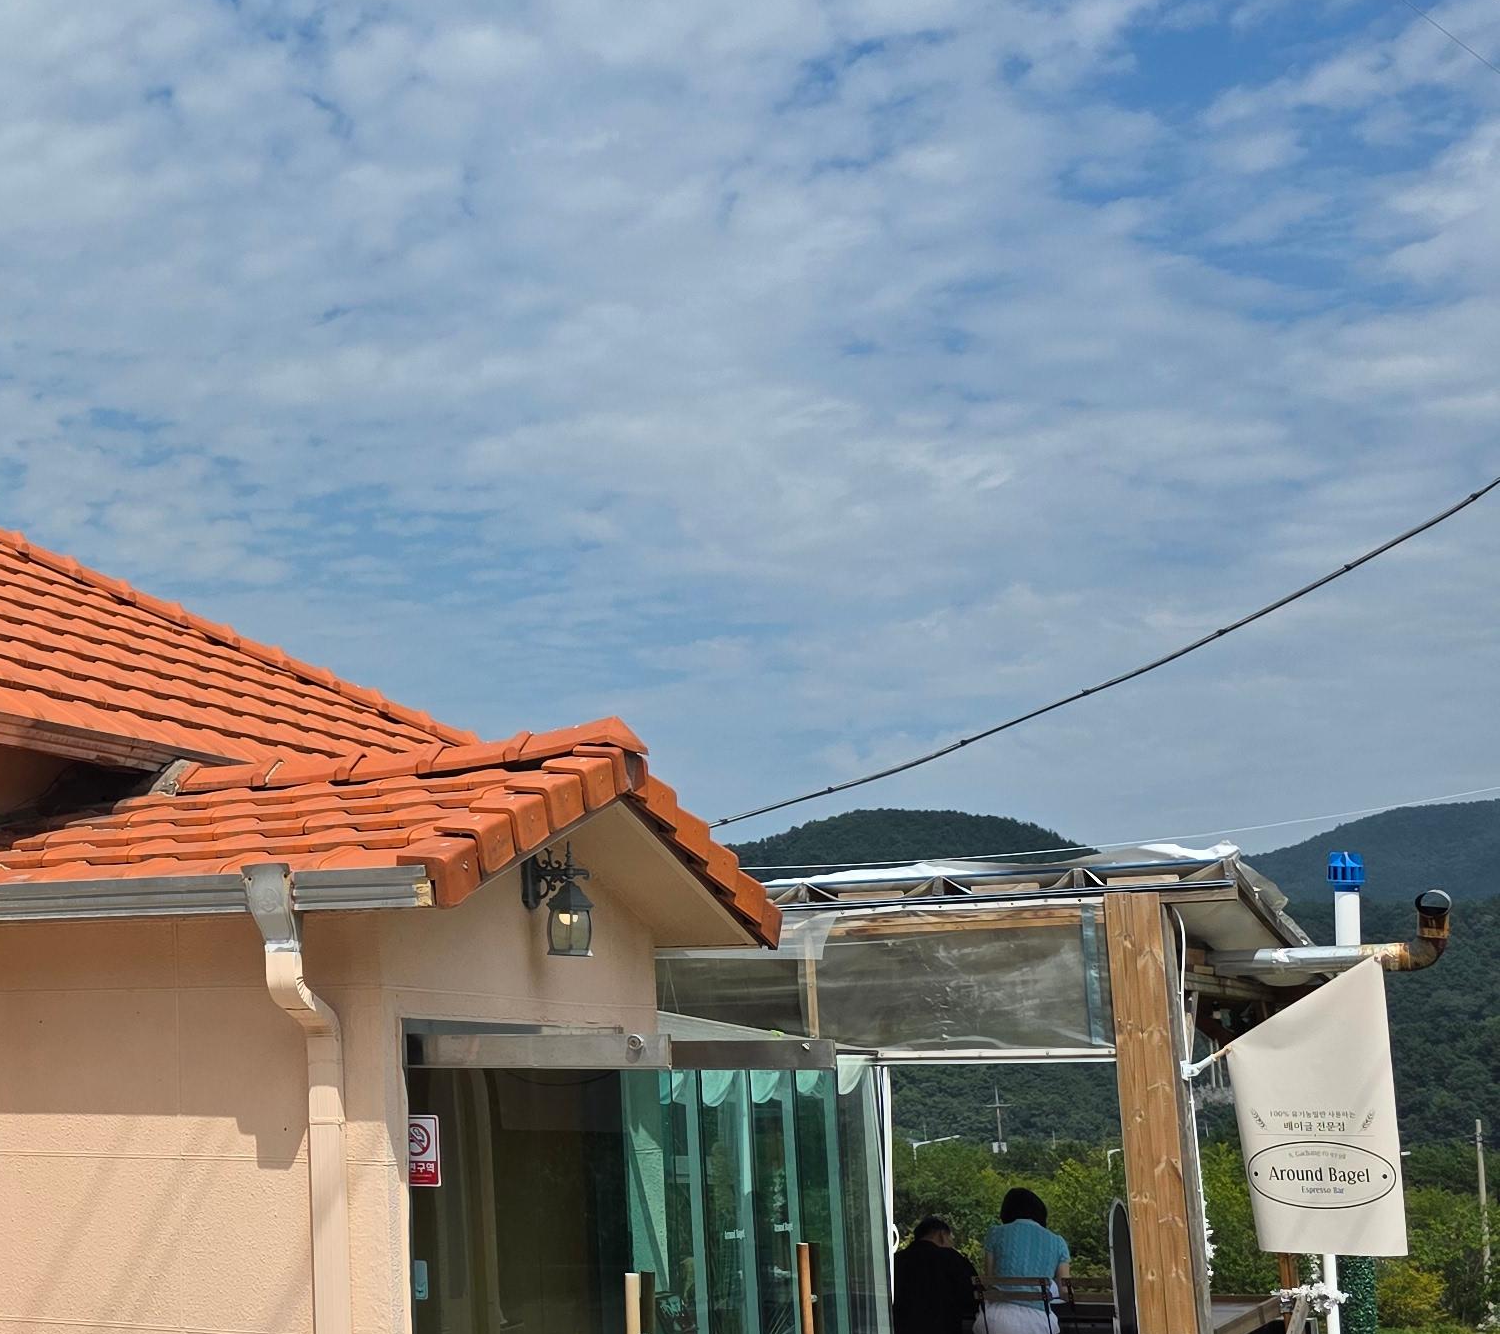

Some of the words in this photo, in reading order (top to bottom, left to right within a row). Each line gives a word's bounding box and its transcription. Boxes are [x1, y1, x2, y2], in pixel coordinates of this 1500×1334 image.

[1284, 1121, 1313, 1131] 베이글
[1269, 1166, 1323, 1181] Around
[1328, 1167, 1370, 1185] Bagel
[1301, 1186, 1331, 1194] Espresso
